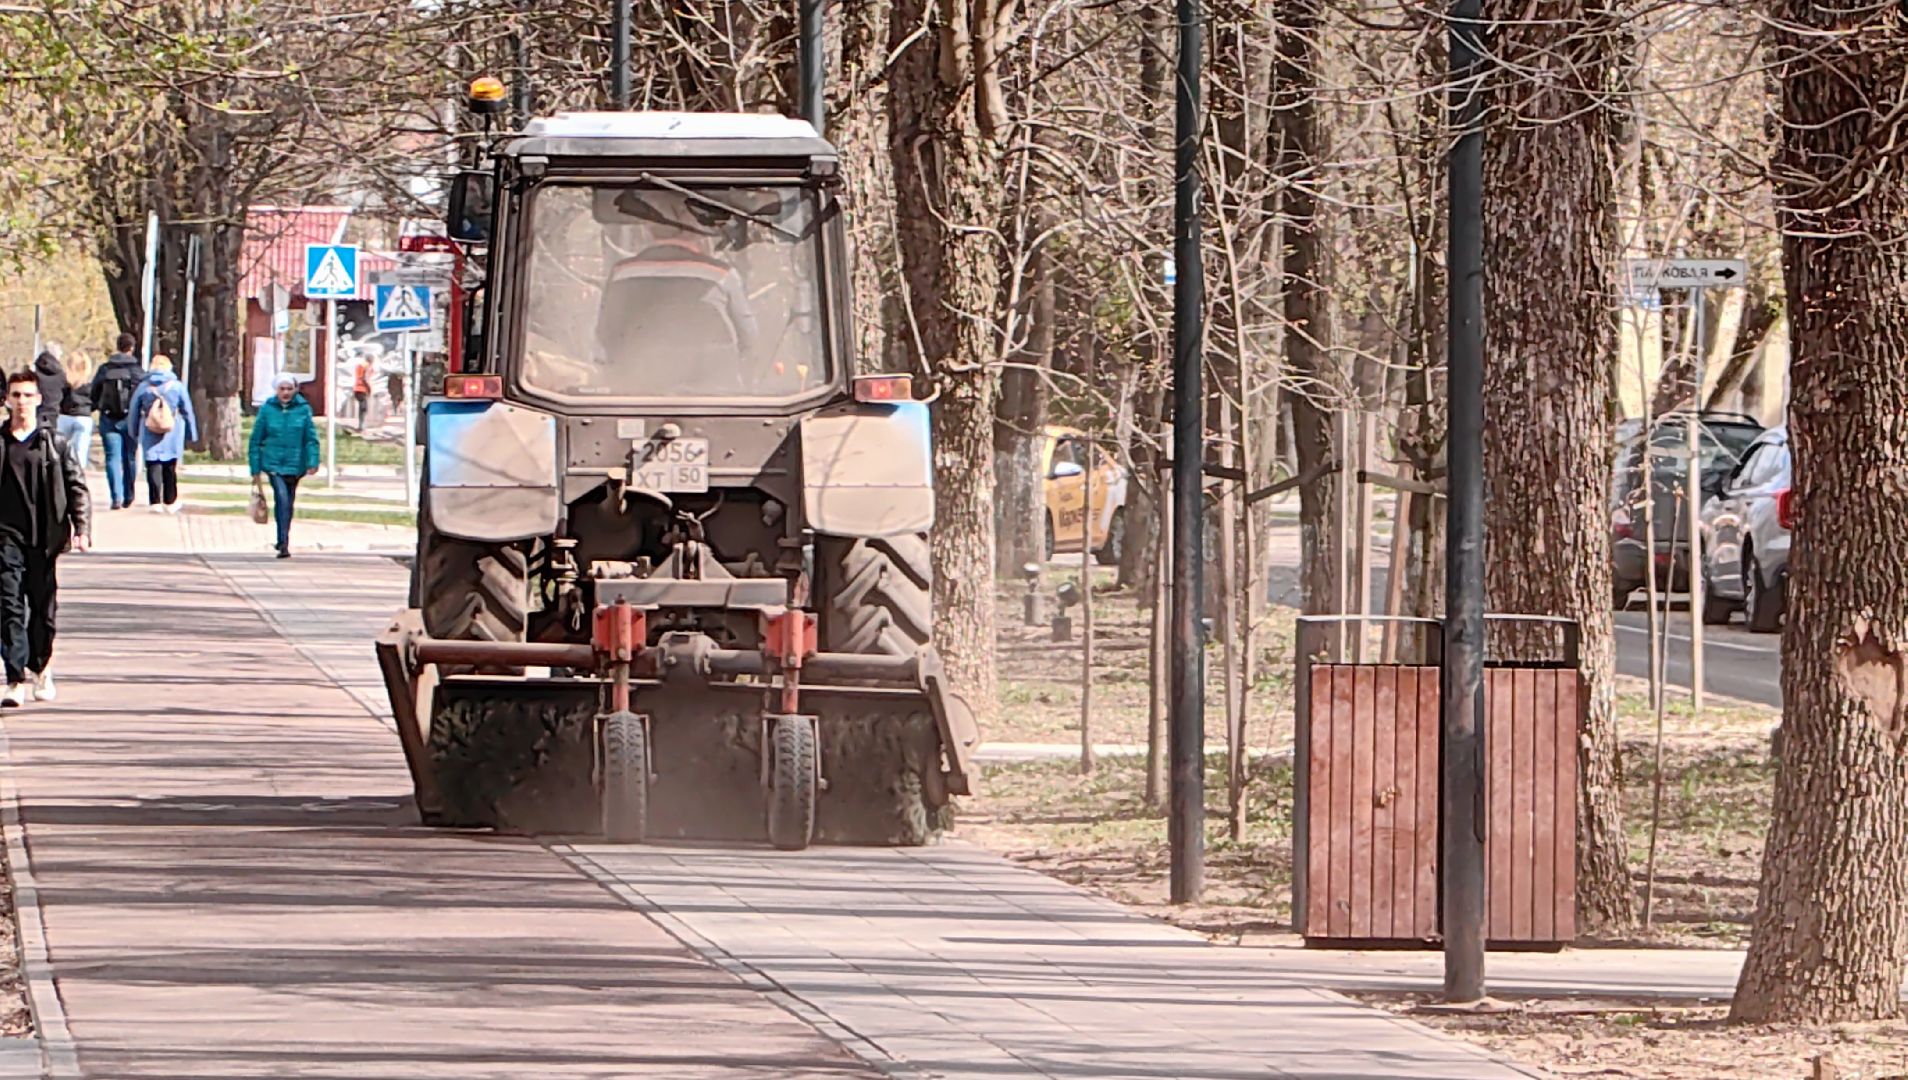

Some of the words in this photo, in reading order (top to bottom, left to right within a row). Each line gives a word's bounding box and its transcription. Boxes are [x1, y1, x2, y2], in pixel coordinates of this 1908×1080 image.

[1633, 266, 1708, 279] ПАКОВАЯ
[641, 441, 699, 463] 2056
[678, 467, 701, 483] 50
